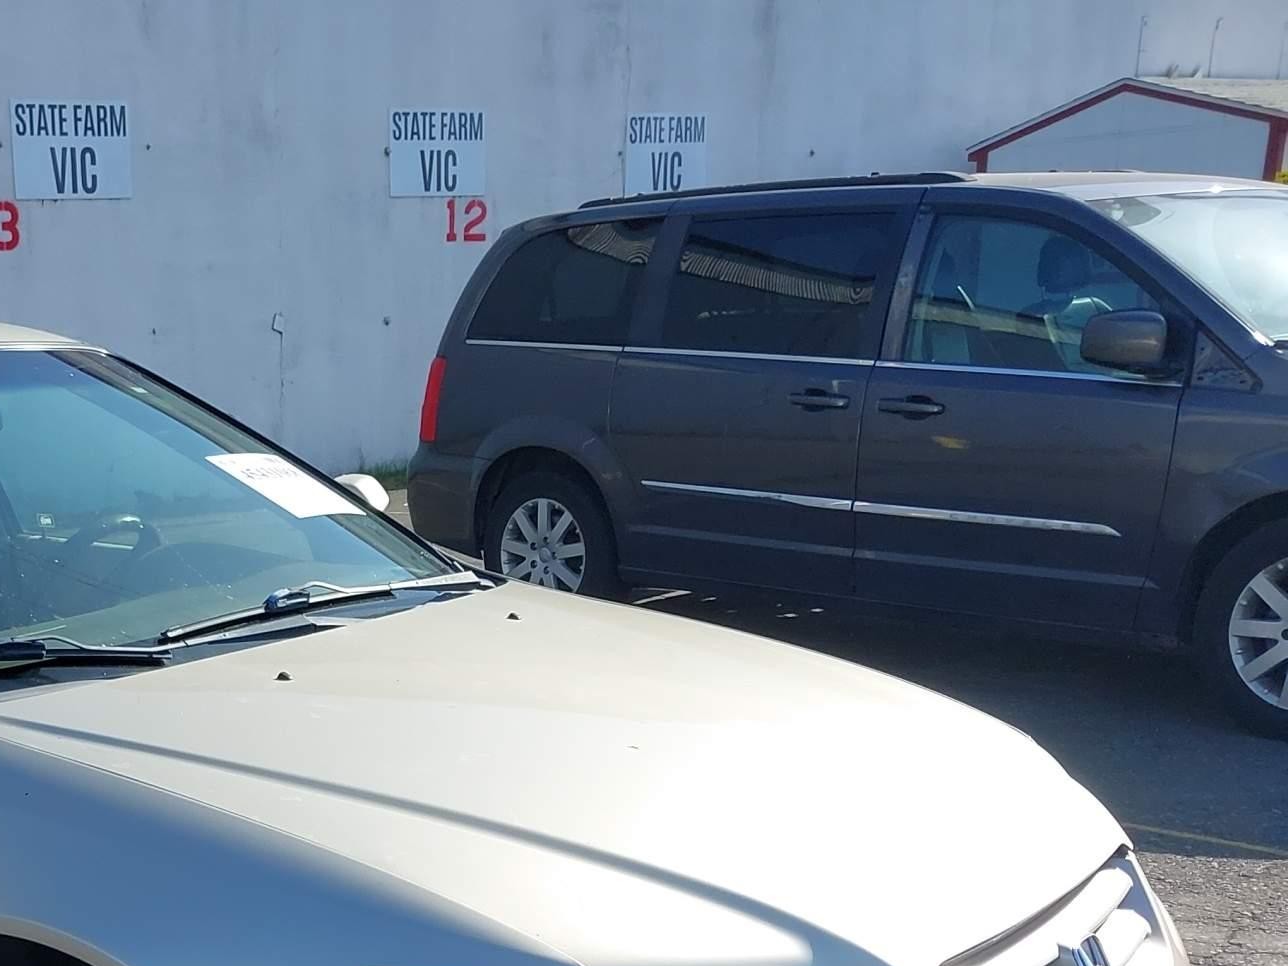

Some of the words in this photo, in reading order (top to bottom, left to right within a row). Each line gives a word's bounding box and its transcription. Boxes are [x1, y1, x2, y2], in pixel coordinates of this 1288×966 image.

[14, 103, 68, 136] STATE
[73, 104, 127, 137] FARM
[392, 111, 436, 141] STATE
[440, 112, 483, 141] FARM
[629, 116, 665, 144] STATE
[668, 116, 705, 143] FARM
[49, 146, 98, 194] VIC
[419, 149, 457, 192] VIC
[651, 151, 682, 192] VIC
[446, 198, 487, 242] 12
